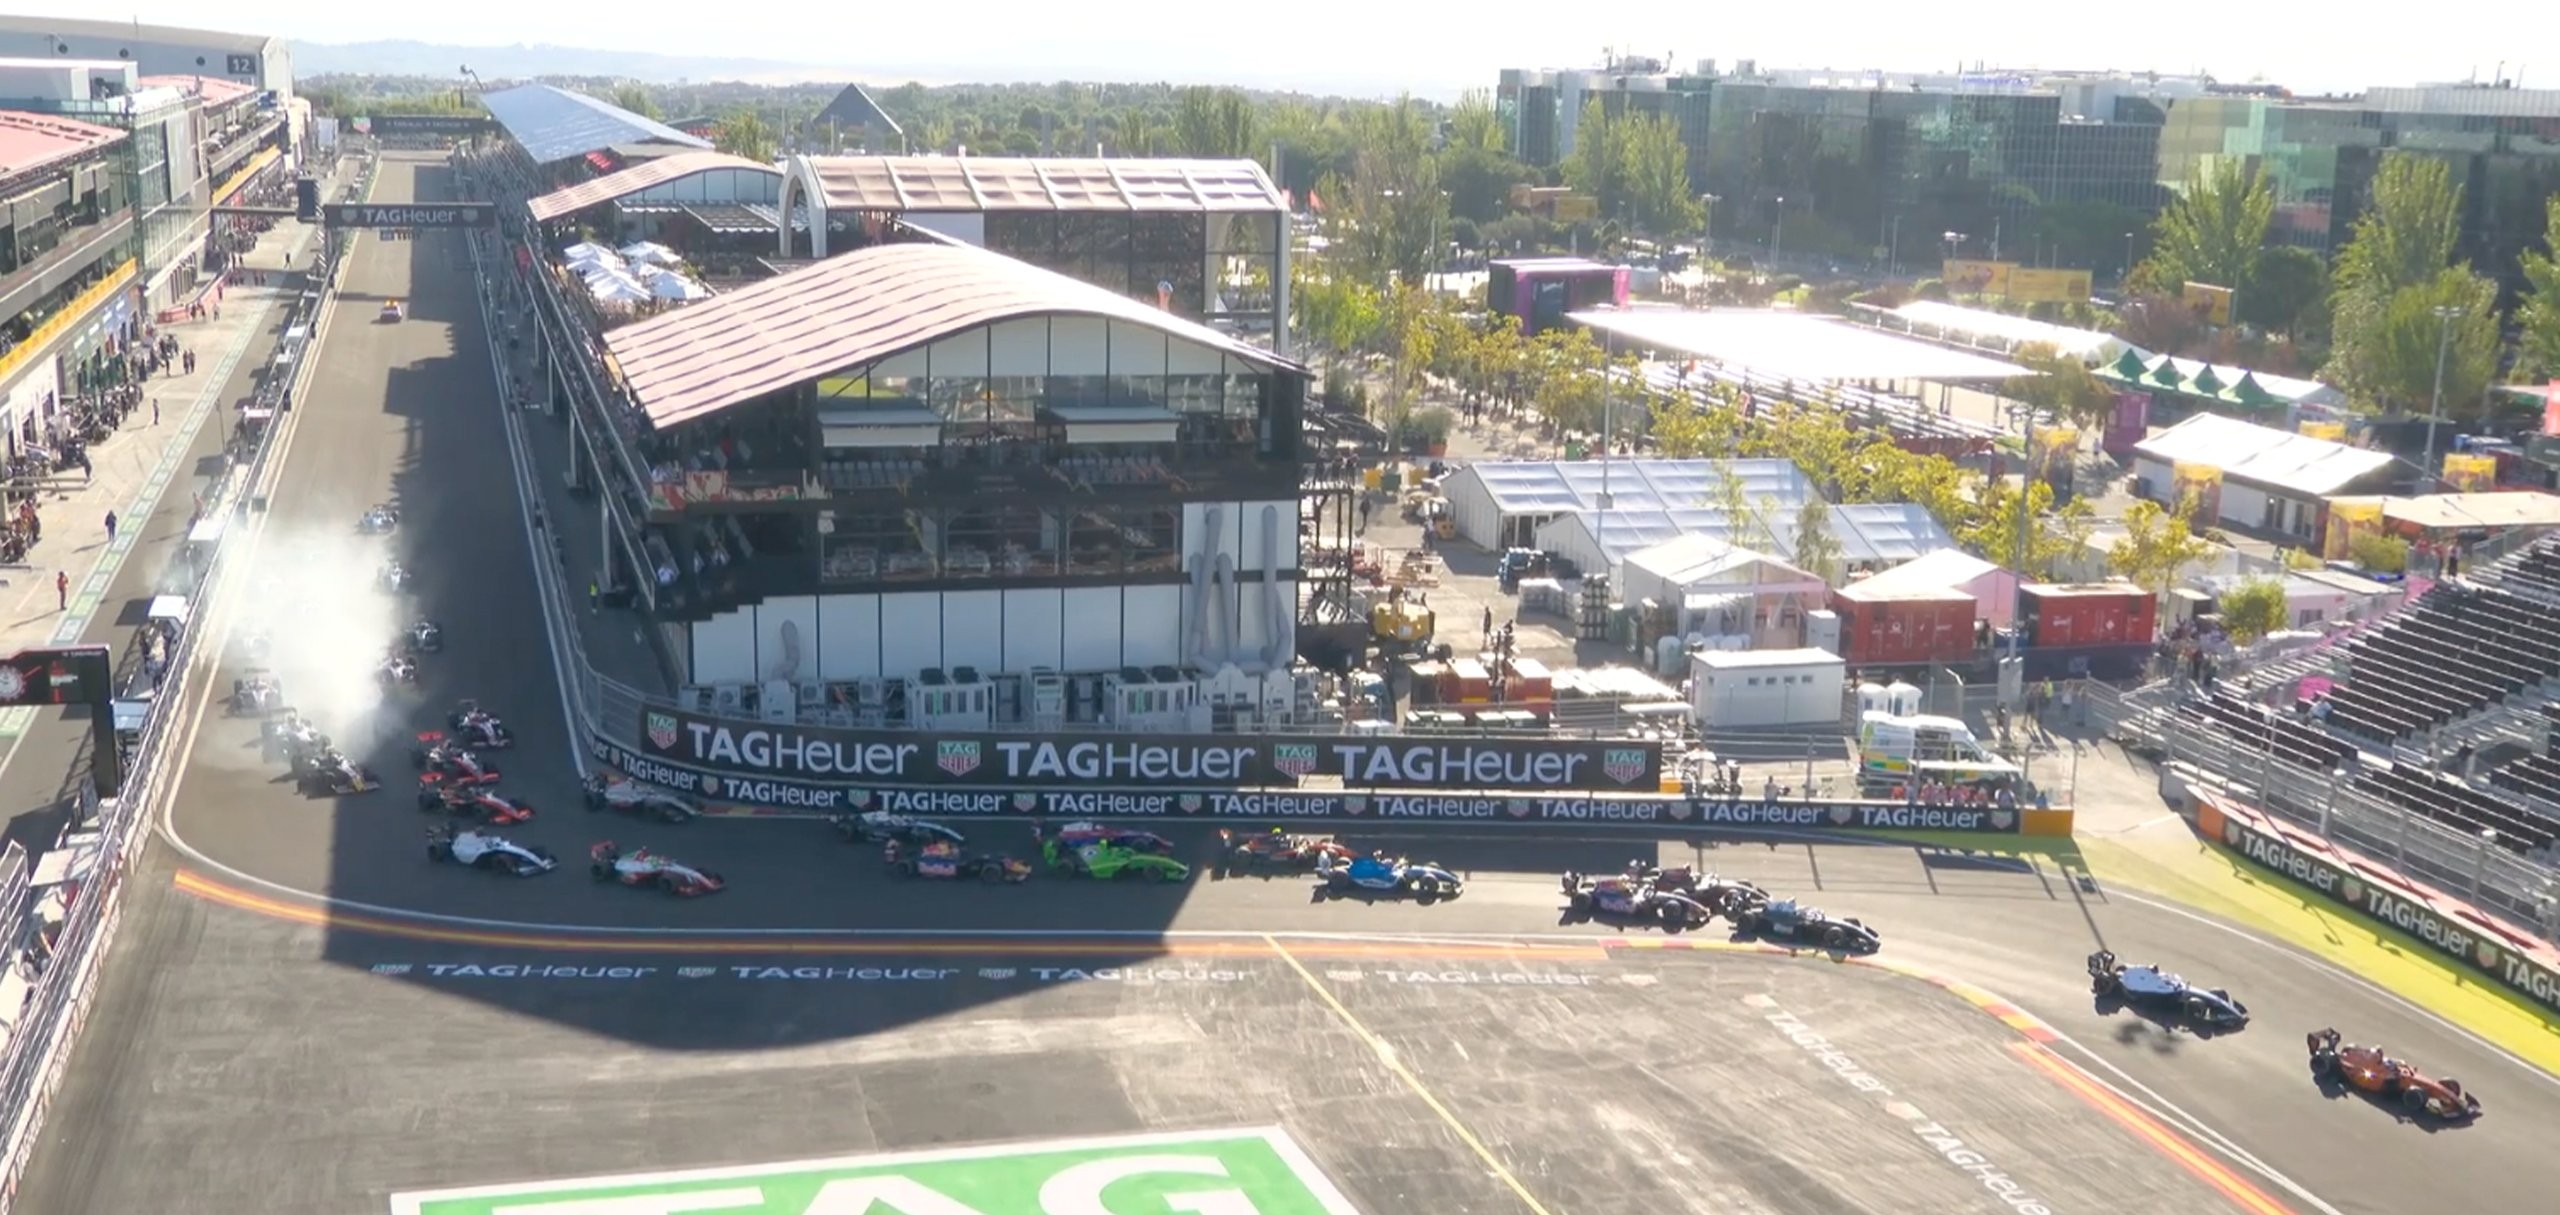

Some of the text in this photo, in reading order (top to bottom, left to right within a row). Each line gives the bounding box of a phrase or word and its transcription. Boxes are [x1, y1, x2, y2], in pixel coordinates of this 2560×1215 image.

[233, 58, 250, 72] 12
[363, 208, 456, 223] TAGHeuer
[687, 722, 918, 775] TAGHeuer
[943, 742, 977, 755] TAG
[1279, 747, 1314, 758] TAG
[1610, 750, 1643, 763] TAG
[996, 741, 1256, 779] TAGHeuer
[1332, 745, 1588, 784] TAGHeuer
[622, 751, 698, 791] TAGHeuer
[724, 778, 842, 807] TAGHeuer
[877, 790, 1006, 812] TAGHeuer
[1043, 793, 1173, 813] TAGHeuer
[1209, 795, 1338, 815] TAGHeuer
[1374, 797, 1501, 818] TAGHeuer
[1537, 799, 1664, 820] TAGHeuer
[1703, 803, 1825, 824] TAGHeuer
[1862, 807, 1985, 829] TAGHeuer
[2243, 833, 2339, 892] TAGHeuer
[2366, 887, 2473, 957] TAGHeuer
[426, 964, 658, 978] TAGHeuer
[730, 966, 960, 980] TAGHeuer
